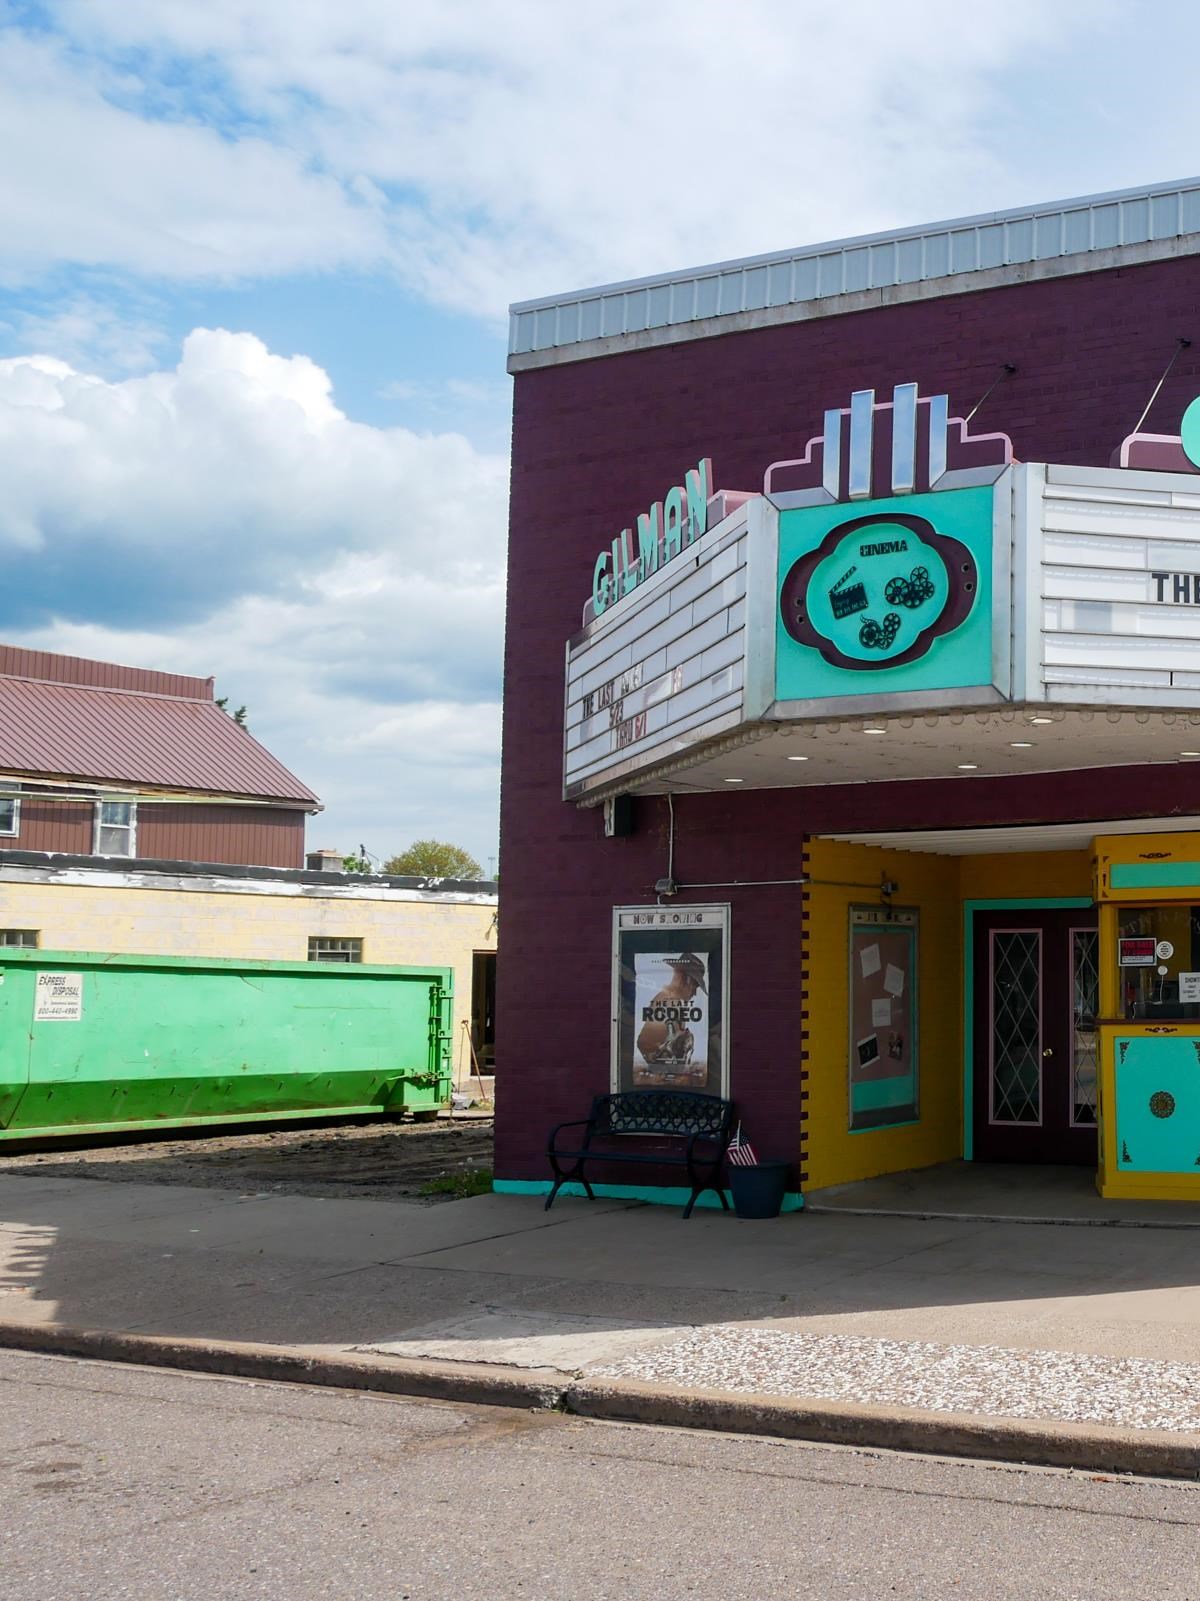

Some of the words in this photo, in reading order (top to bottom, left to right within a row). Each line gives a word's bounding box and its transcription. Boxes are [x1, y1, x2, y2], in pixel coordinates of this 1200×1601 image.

[593, 458, 712, 616] GILMAN
[860, 540, 907, 557] CINEMA
[582, 694, 593, 721] THE
[597, 680, 614, 711] LAST
[634, 711, 646, 740] 6/1
[633, 914, 654, 924] NOW
[642, 1007, 702, 1022] RODEO
